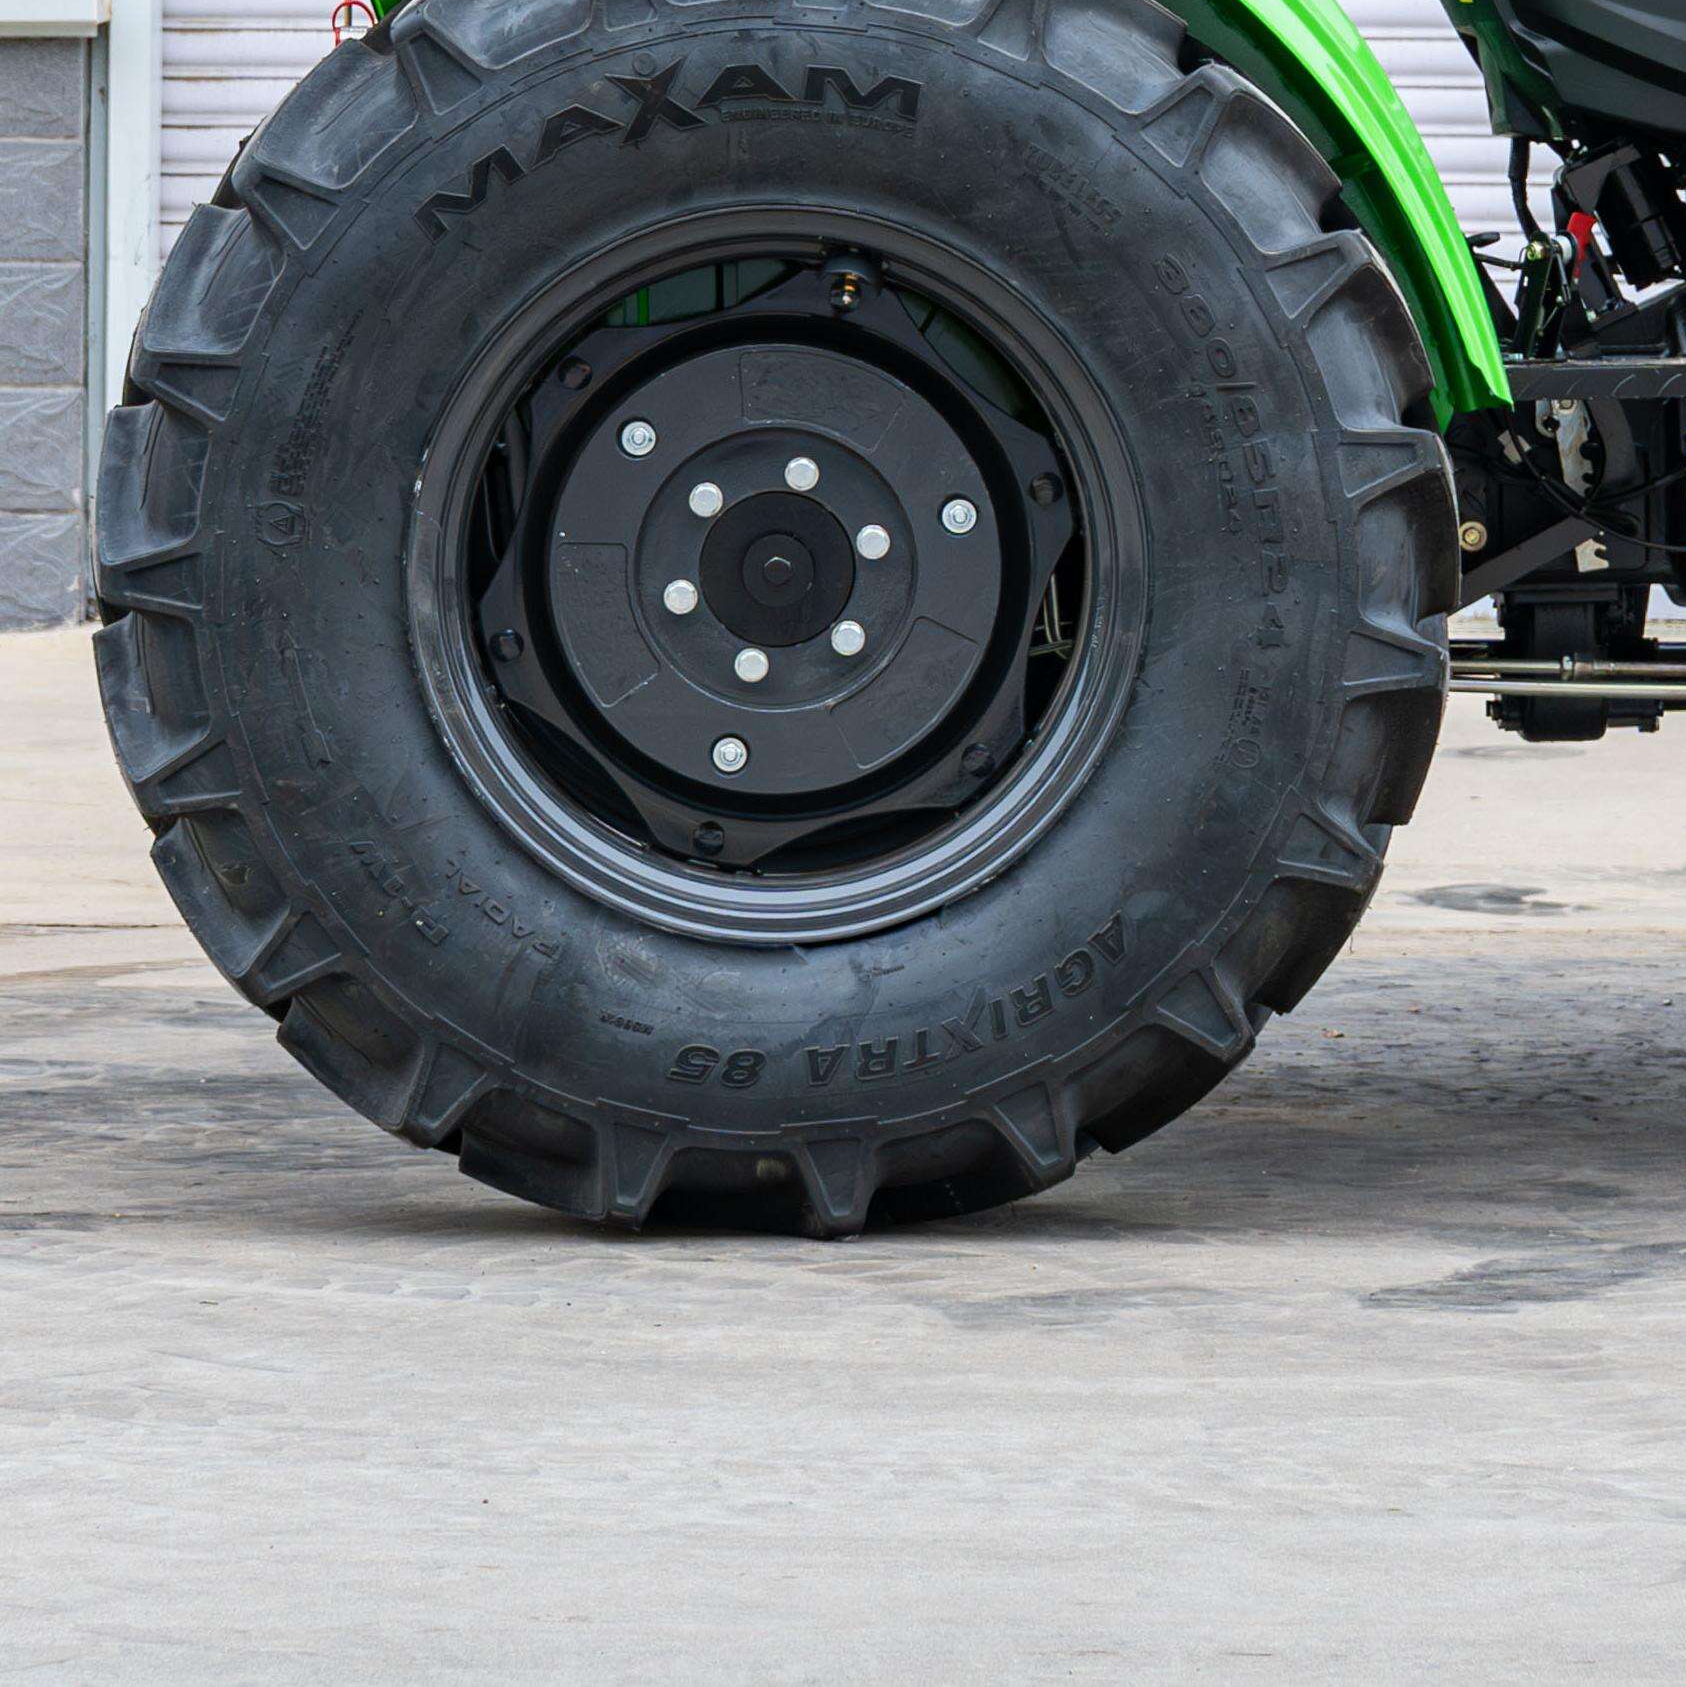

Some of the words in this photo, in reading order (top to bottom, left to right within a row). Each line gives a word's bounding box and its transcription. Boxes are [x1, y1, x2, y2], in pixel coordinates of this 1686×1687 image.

[414, 56, 924, 243] MAXAM
[1154, 250, 1289, 650] 380/85R24
[445, 859, 563, 961] RADIAL
[803, 909, 1126, 1086] AGRIXTRA
[665, 1042, 767, 1088] 85
